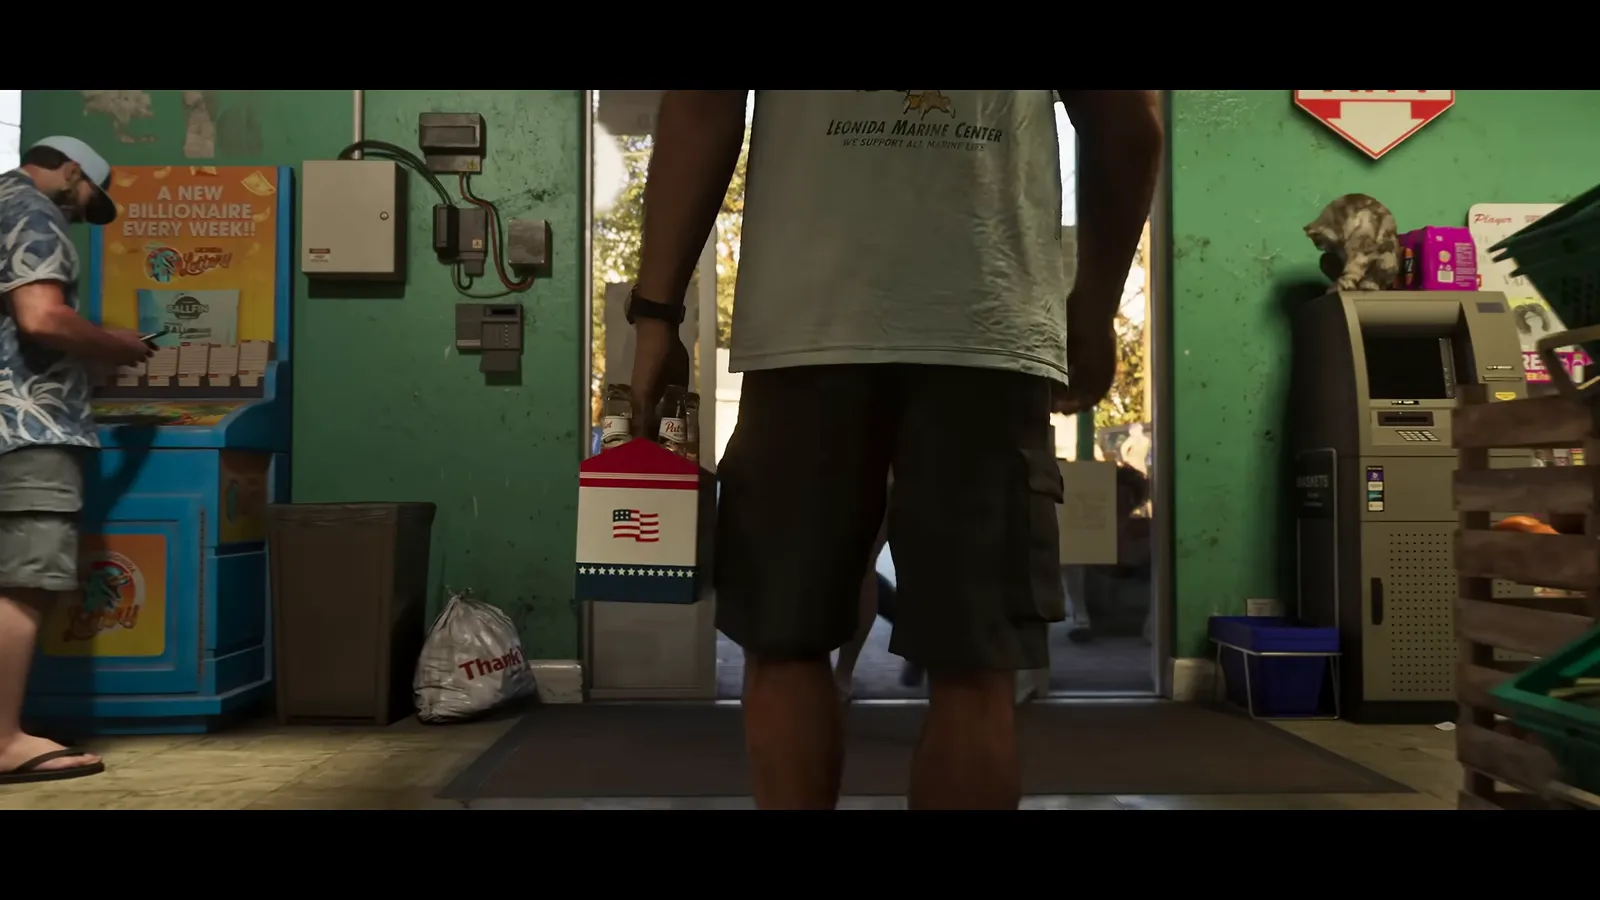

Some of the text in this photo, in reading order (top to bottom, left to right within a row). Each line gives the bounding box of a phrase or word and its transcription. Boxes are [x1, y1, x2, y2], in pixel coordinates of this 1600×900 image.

[826, 119, 1003, 143] LEONIDA MARINE CENTER
[842, 137, 986, 152] WE SUPPORT ALL MARINE LIFE
[156, 185, 223, 201] A NEW
[128, 203, 253, 219] BILLIONAIRE
[122, 221, 256, 237] EVERY WEEK!!
[458, 647, 521, 681] Thank
